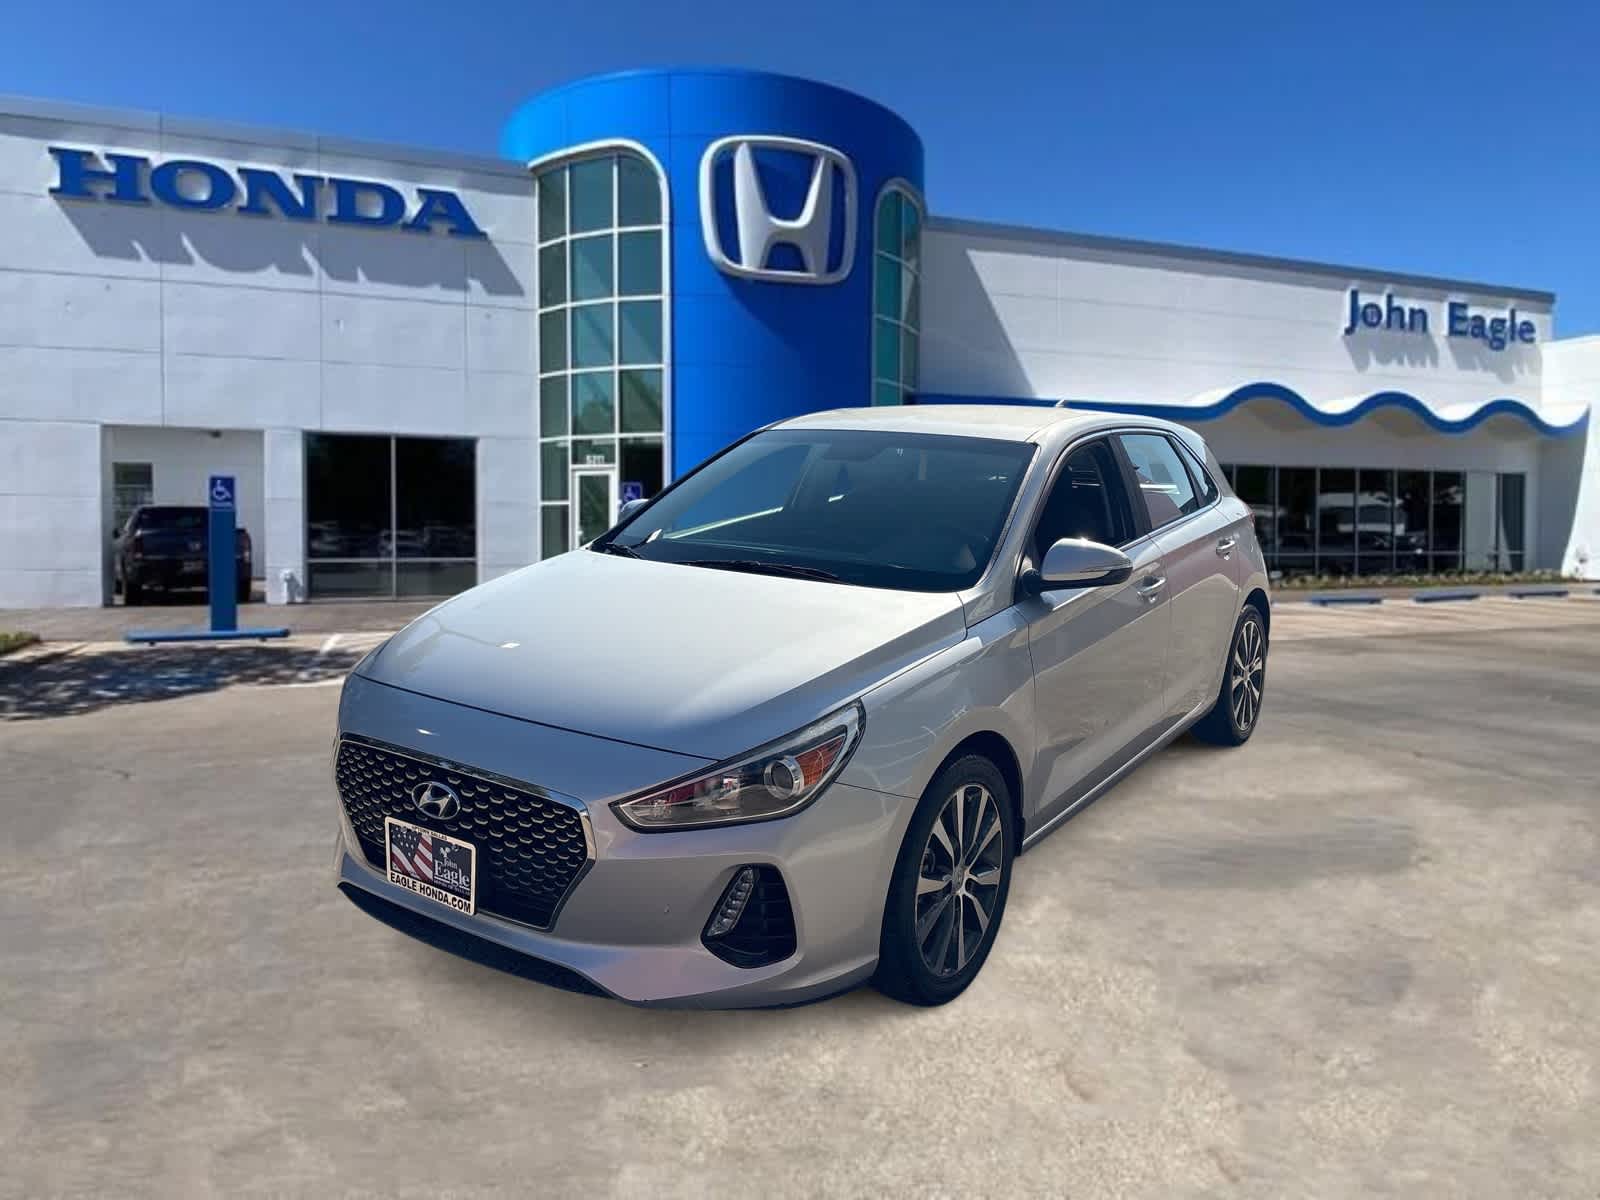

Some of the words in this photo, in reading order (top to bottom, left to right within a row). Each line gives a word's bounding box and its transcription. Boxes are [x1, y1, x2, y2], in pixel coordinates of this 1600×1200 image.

[48, 146, 489, 241] HONDA
[1344, 289, 1429, 336] John
[1448, 301, 1537, 351] Eagle
[390, 872, 418, 892] EAGLE
[419, 885, 472, 914] HONDA.COM
[434, 859, 470, 887] Eagle
